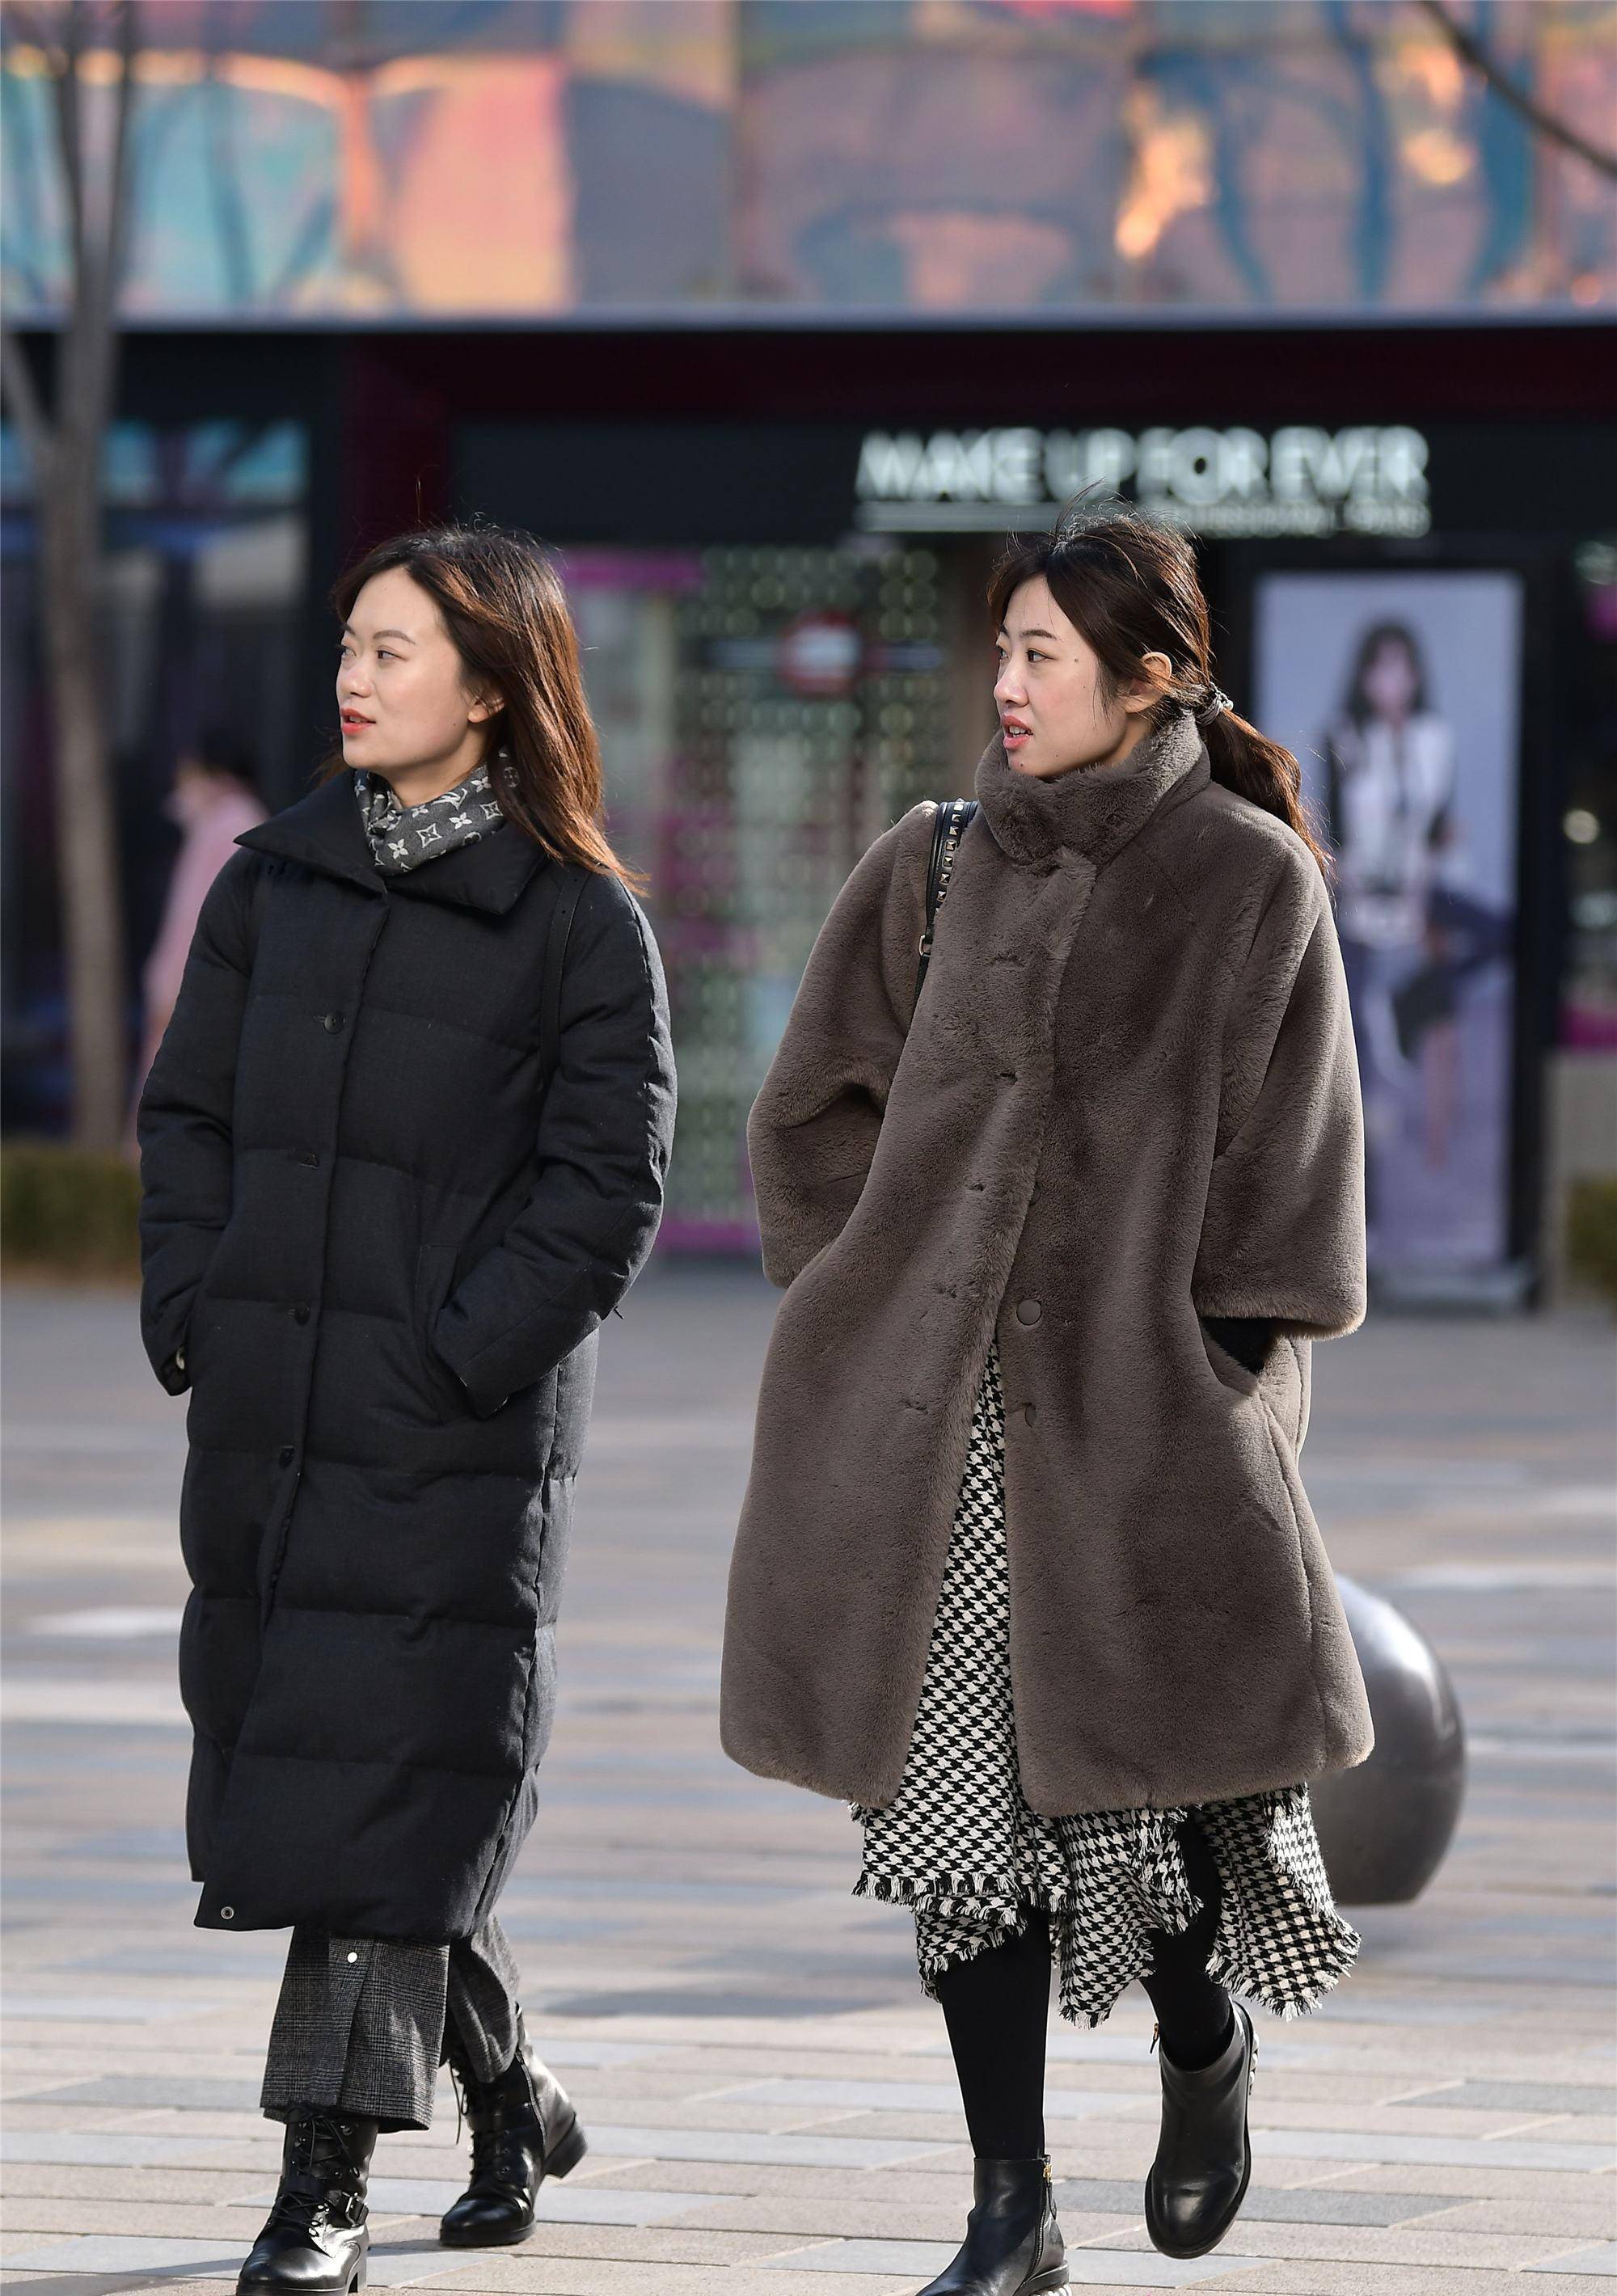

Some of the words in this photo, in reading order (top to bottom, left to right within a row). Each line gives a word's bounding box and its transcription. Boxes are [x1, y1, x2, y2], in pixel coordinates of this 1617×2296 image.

[856, 428, 1042, 501] MAKE
[1045, 428, 1134, 503] UP
[1137, 427, 1269, 503] FOR
[1271, 426, 1429, 501] EVER
